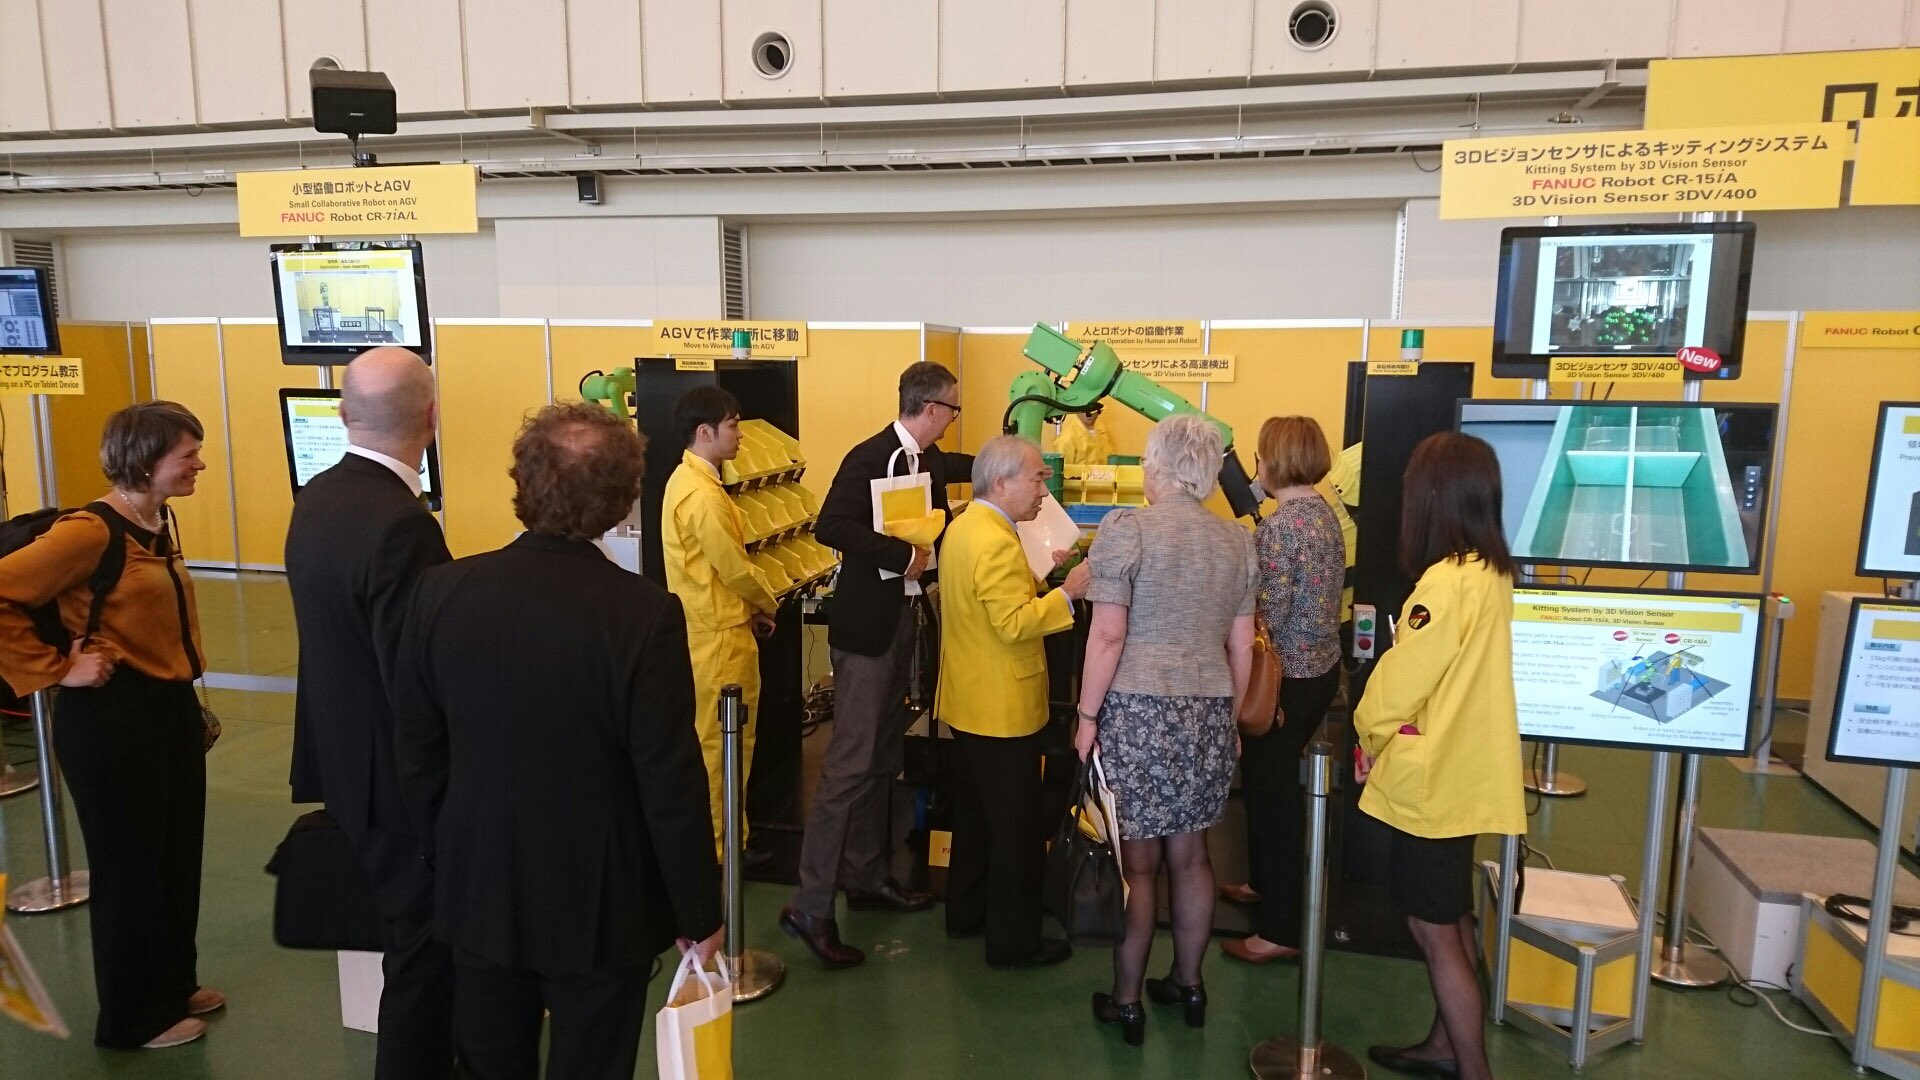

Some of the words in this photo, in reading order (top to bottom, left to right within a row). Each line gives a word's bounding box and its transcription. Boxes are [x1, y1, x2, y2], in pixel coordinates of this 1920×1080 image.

[1454, 135, 1828, 164] 3Dビジョンセンサによるキッティングシステム
[1525, 164, 1566, 175] Kitting
[1571, 163, 1616, 174] System
[1621, 161, 1635, 172] by
[1639, 160, 1656, 170] 3D
[1659, 158, 1698, 169] Vision
[1703, 158, 1747, 168] Sensor
[1532, 177, 1596, 190] FANUC
[1602, 176, 1656, 188] Robot
[1662, 169, 1738, 185] CR-15iA
[292, 180, 411, 195] 小型協働ロボットとAGV
[288, 200, 310, 208] Small
[311, 199, 361, 208] Collaborative
[363, 198, 385, 207] Robot
[399, 198, 417, 206] AGV
[1512, 195, 1536, 206] 3D
[1541, 194, 1597, 205] Vision
[1603, 192, 1669, 203] Sensor
[1675, 189, 1757, 201] 3DV/400
[281, 211, 325, 222] FANUC
[330, 212, 363, 222] Robot
[366, 208, 418, 221] CR-7iA/L
[660, 327, 799, 342] AGVで作業所に移動
[1082, 326, 1184, 337] 人とロボットの協働作業
[1825, 327, 1868, 336] FANUC
[1872, 327, 1909, 336] Robot
[1107, 337, 1135, 345] Operation
[1680, 348, 1718, 369] New
[1555, 362, 1627, 371] 3Dビジョンセンサ
[1631, 362, 1680, 371] 3DV/400
[24, 380, 32, 388] PC
[41, 380, 58, 388] Tablet
[59, 380, 79, 388] Device
[1532, 605, 1559, 613] Kitting
[1562, 606, 1591, 615] System
[1593, 607, 1602, 615] by
[1646, 610, 1675, 618] Sensor
